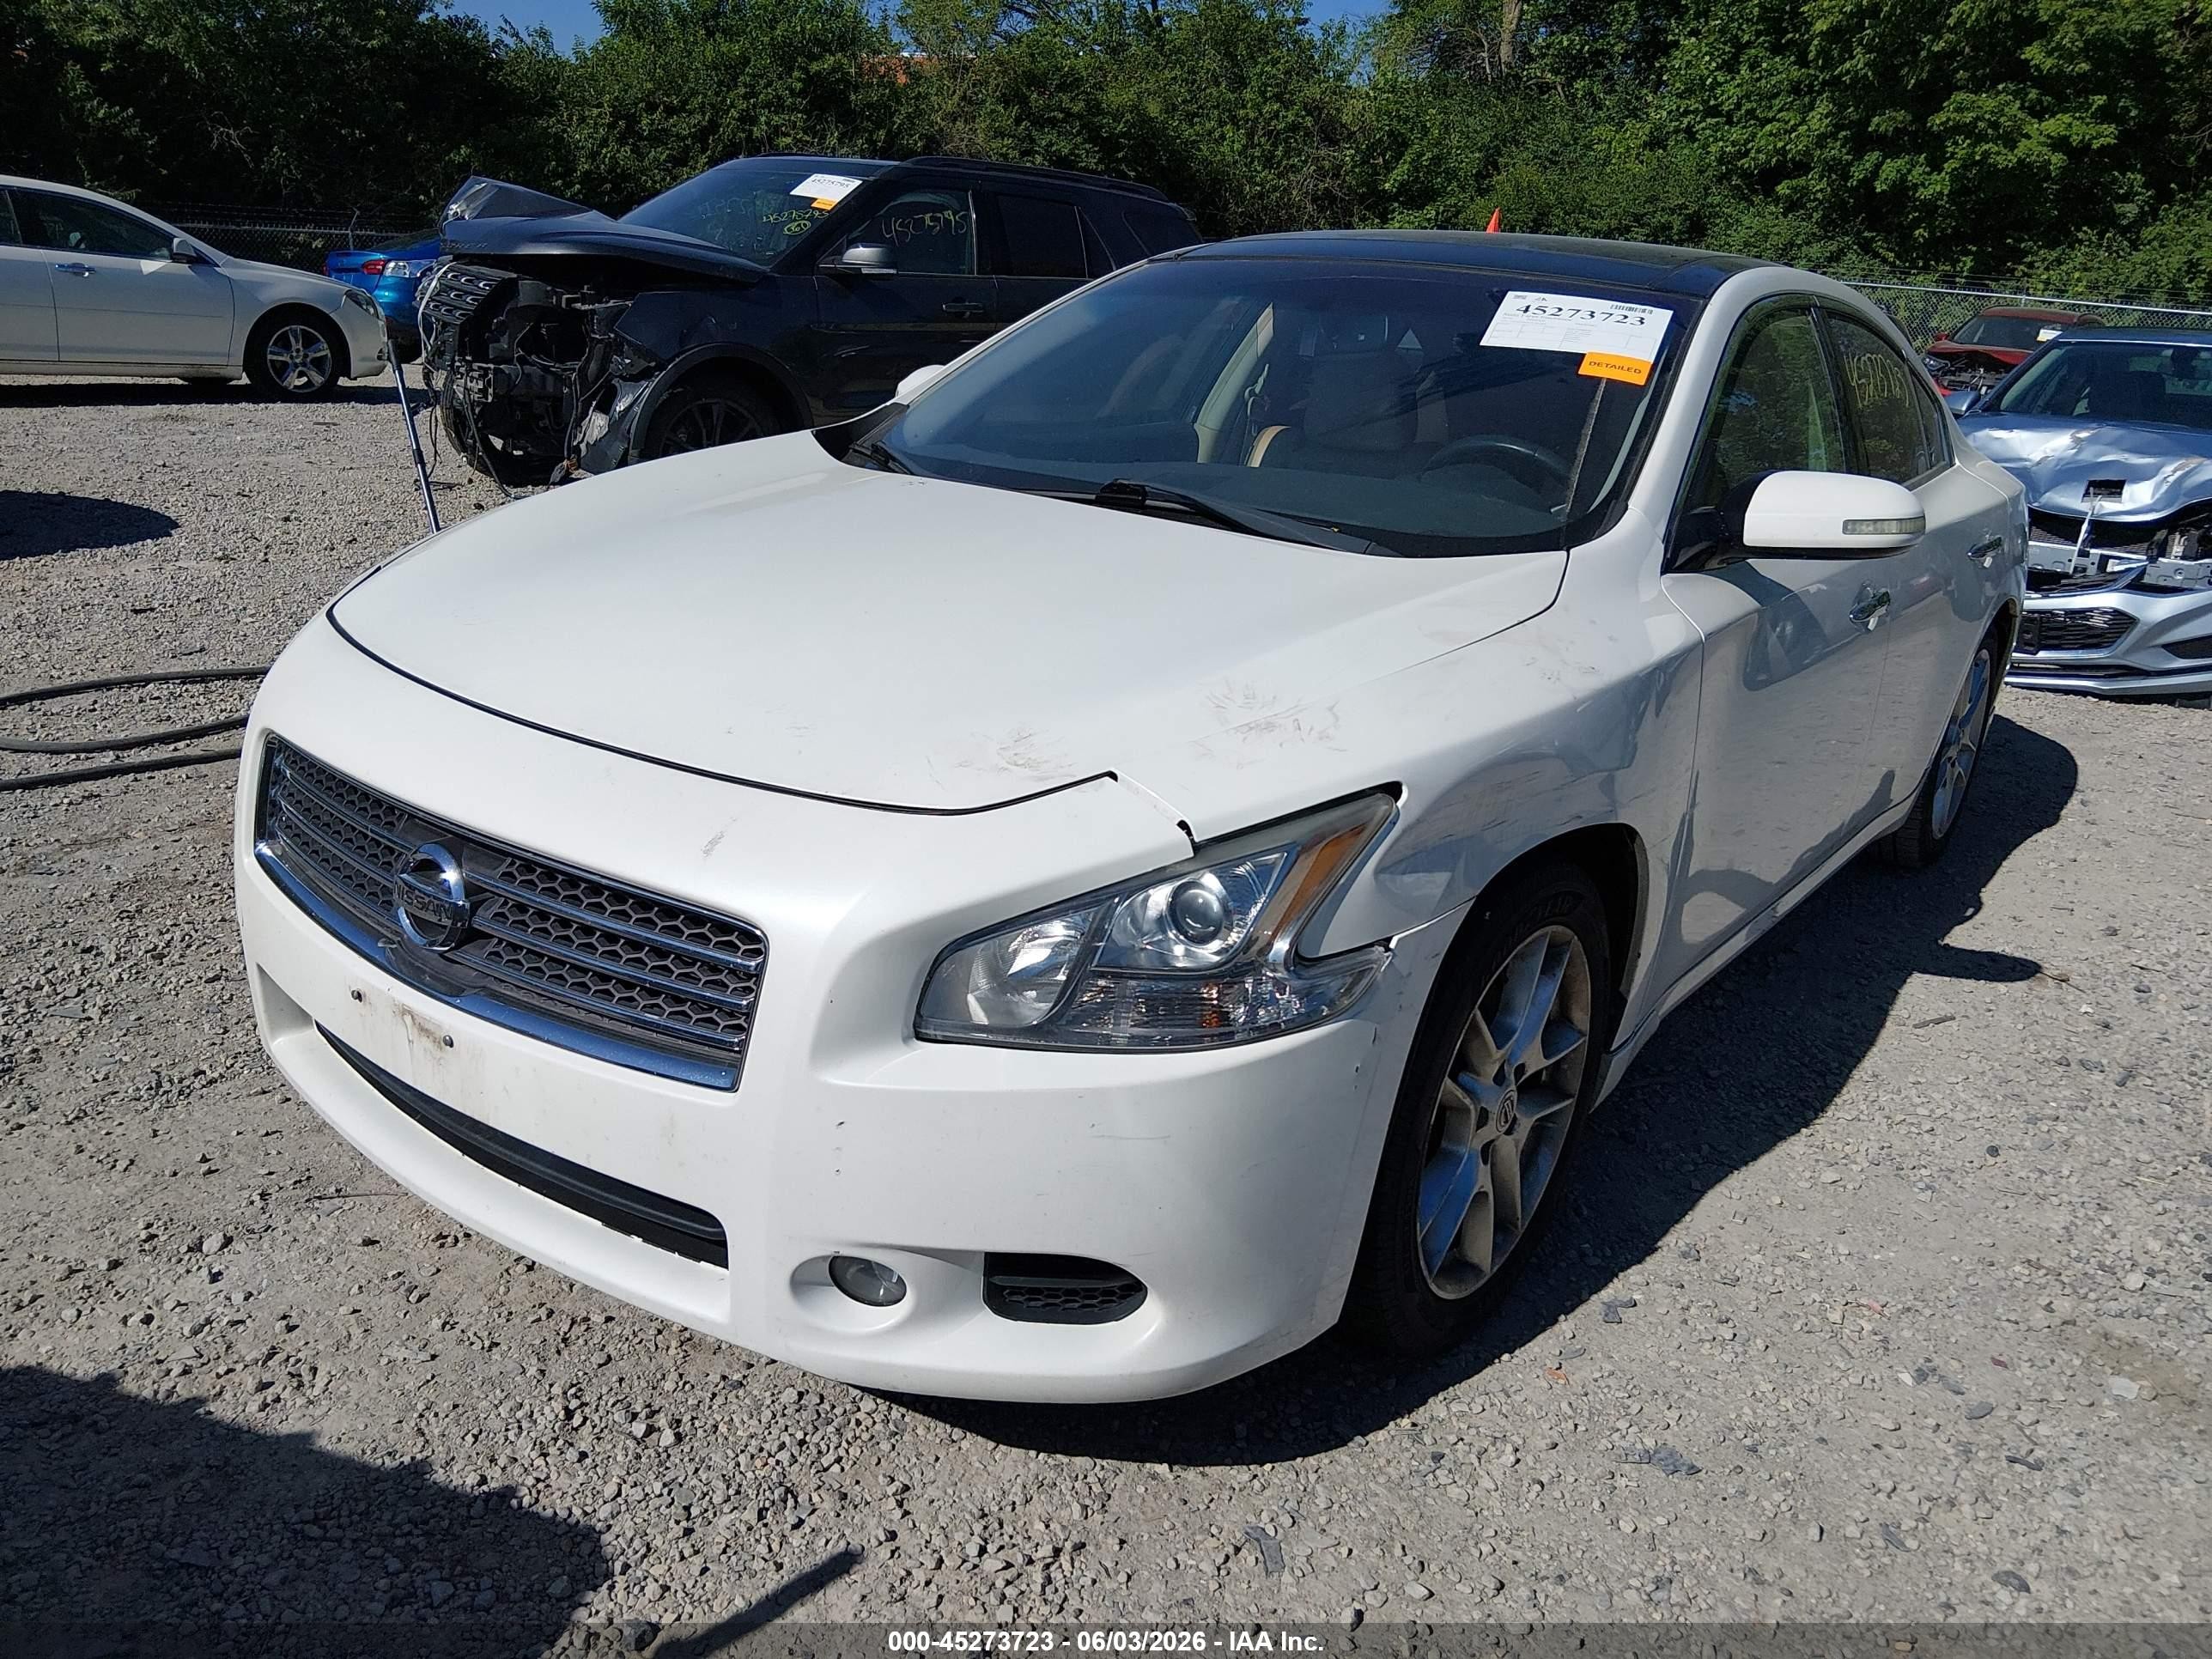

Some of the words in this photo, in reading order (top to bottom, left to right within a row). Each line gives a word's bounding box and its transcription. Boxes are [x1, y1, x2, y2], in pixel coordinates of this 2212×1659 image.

[1516, 303, 1647, 326] 45273723
[1588, 360, 1642, 374] DETAILED
[392, 883, 453, 922] NISSAN
